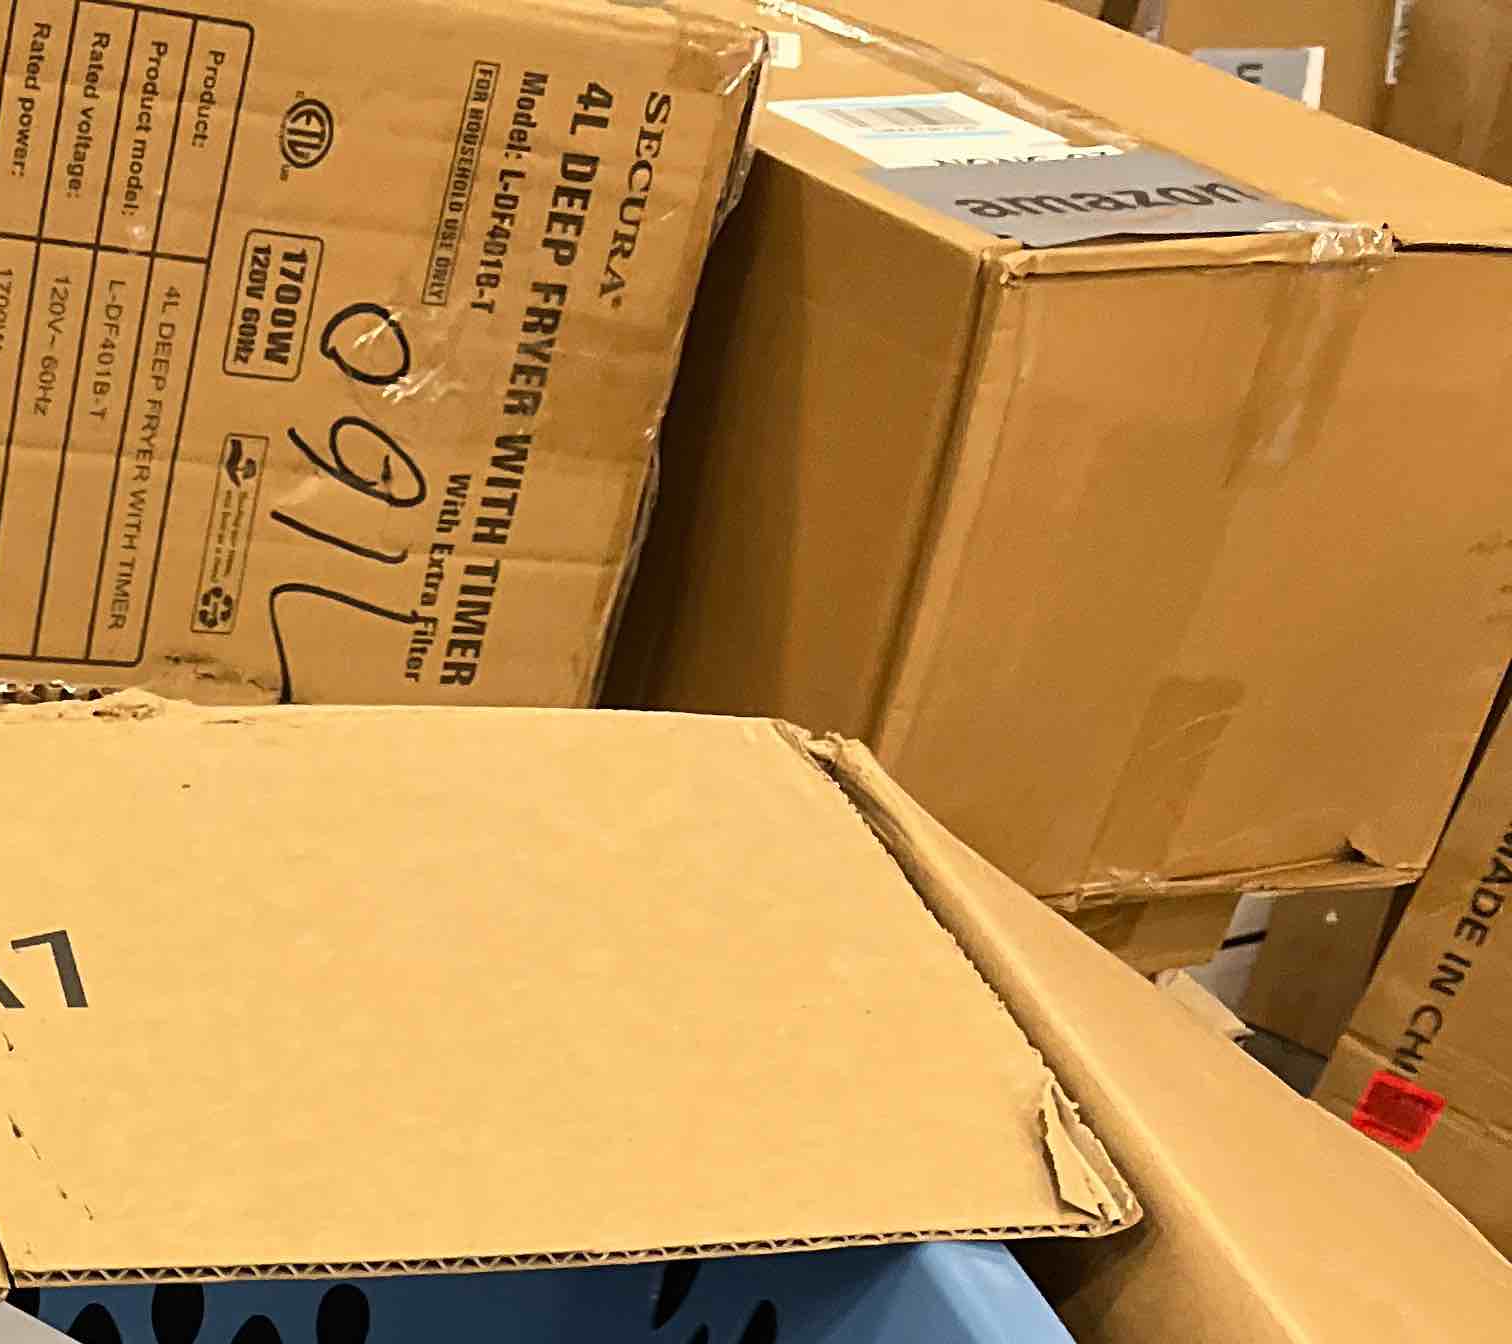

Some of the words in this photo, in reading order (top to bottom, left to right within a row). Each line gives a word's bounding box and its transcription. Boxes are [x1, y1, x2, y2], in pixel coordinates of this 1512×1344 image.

[24, 21, 52, 91] Rated
[83, 31, 111, 100] Rated
[135, 40, 169, 134] Product
[472, 69, 493, 102] FOR
[191, 49, 226, 149] Product:
[504, 71, 549, 161] Model:
[569, 81, 614, 135] 4L
[11, 96, 36, 177] power:
[66, 106, 95, 199] voltage:
[448, 107, 485, 212] HOUSEHOLD
[121, 138, 148, 217] model:
[541, 152, 601, 267] DEEP
[954, 183, 1261, 218] amazon
[439, 218, 459, 249] USE
[161, 285, 182, 314] 4L
[245, 244, 273, 300] 120V
[264, 248, 308, 365] 1700W
[428, 256, 451, 299] ONLY
[151, 322, 176, 392] DEEP
[234, 307, 261, 364] 60Hz
[503, 281, 568, 418] FRYER
[33, 355, 59, 417] 60Hz
[135, 398, 164, 482] FRYER
[121, 488, 147, 550] WITH
[436, 473, 472, 534] With
[471, 434, 534, 545] WITH
[108, 555, 137, 630] TIMER
[420, 542, 456, 608] Extra
[404, 612, 439, 683] Filter
[440, 559, 501, 688] TIMER
[1429, 952, 1473, 997] IN
